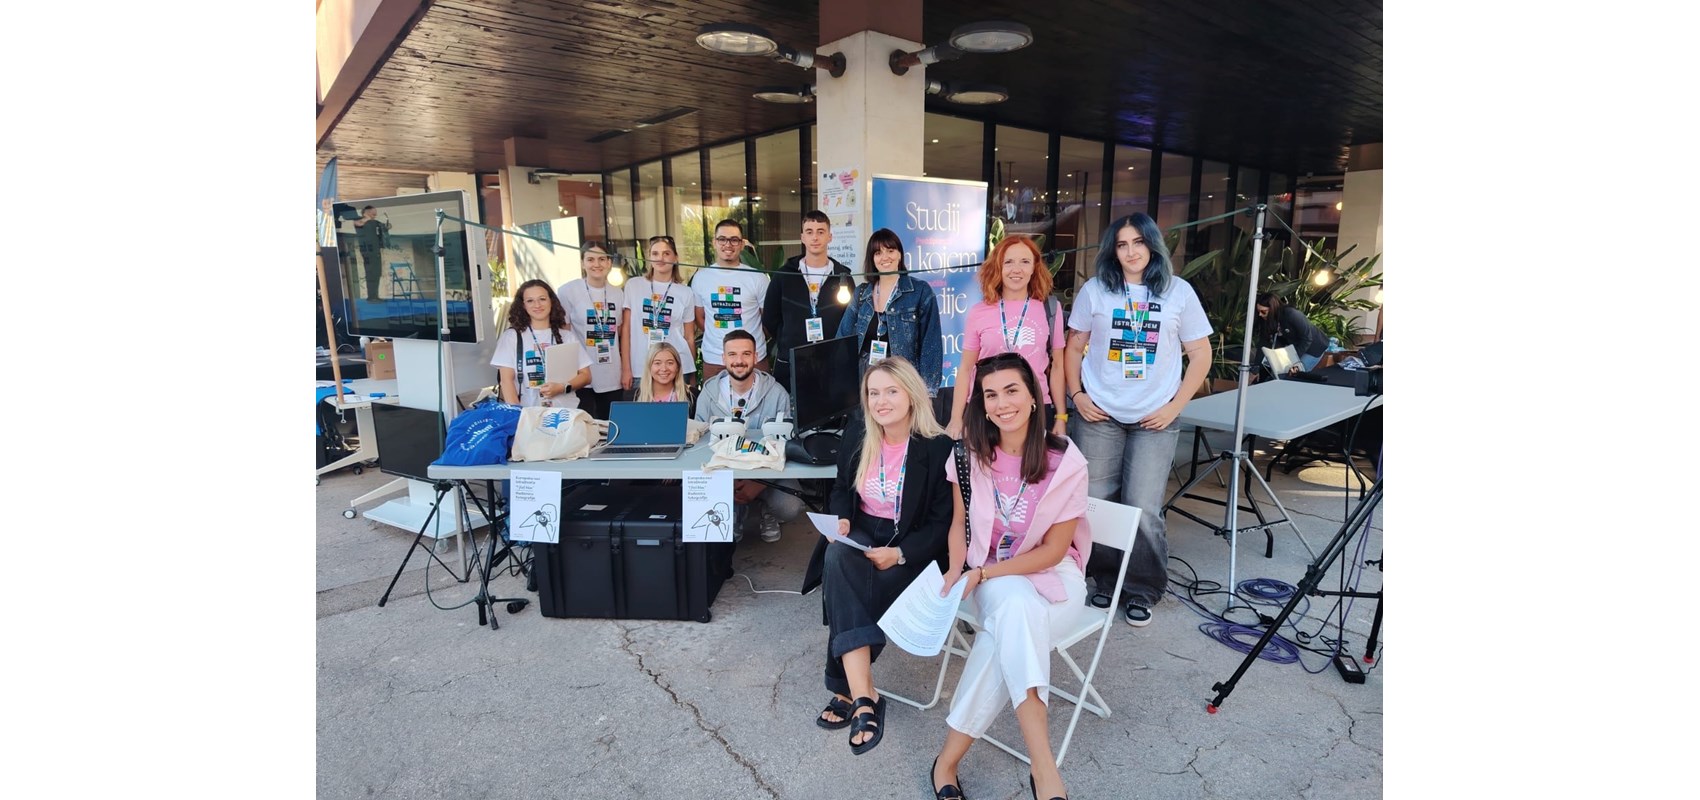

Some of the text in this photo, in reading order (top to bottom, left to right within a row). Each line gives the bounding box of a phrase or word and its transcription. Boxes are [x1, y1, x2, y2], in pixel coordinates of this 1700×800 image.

[906, 201, 960, 236] Studij
[917, 245, 978, 278] kojem
[1114, 320, 1158, 329] ISTRJEM
